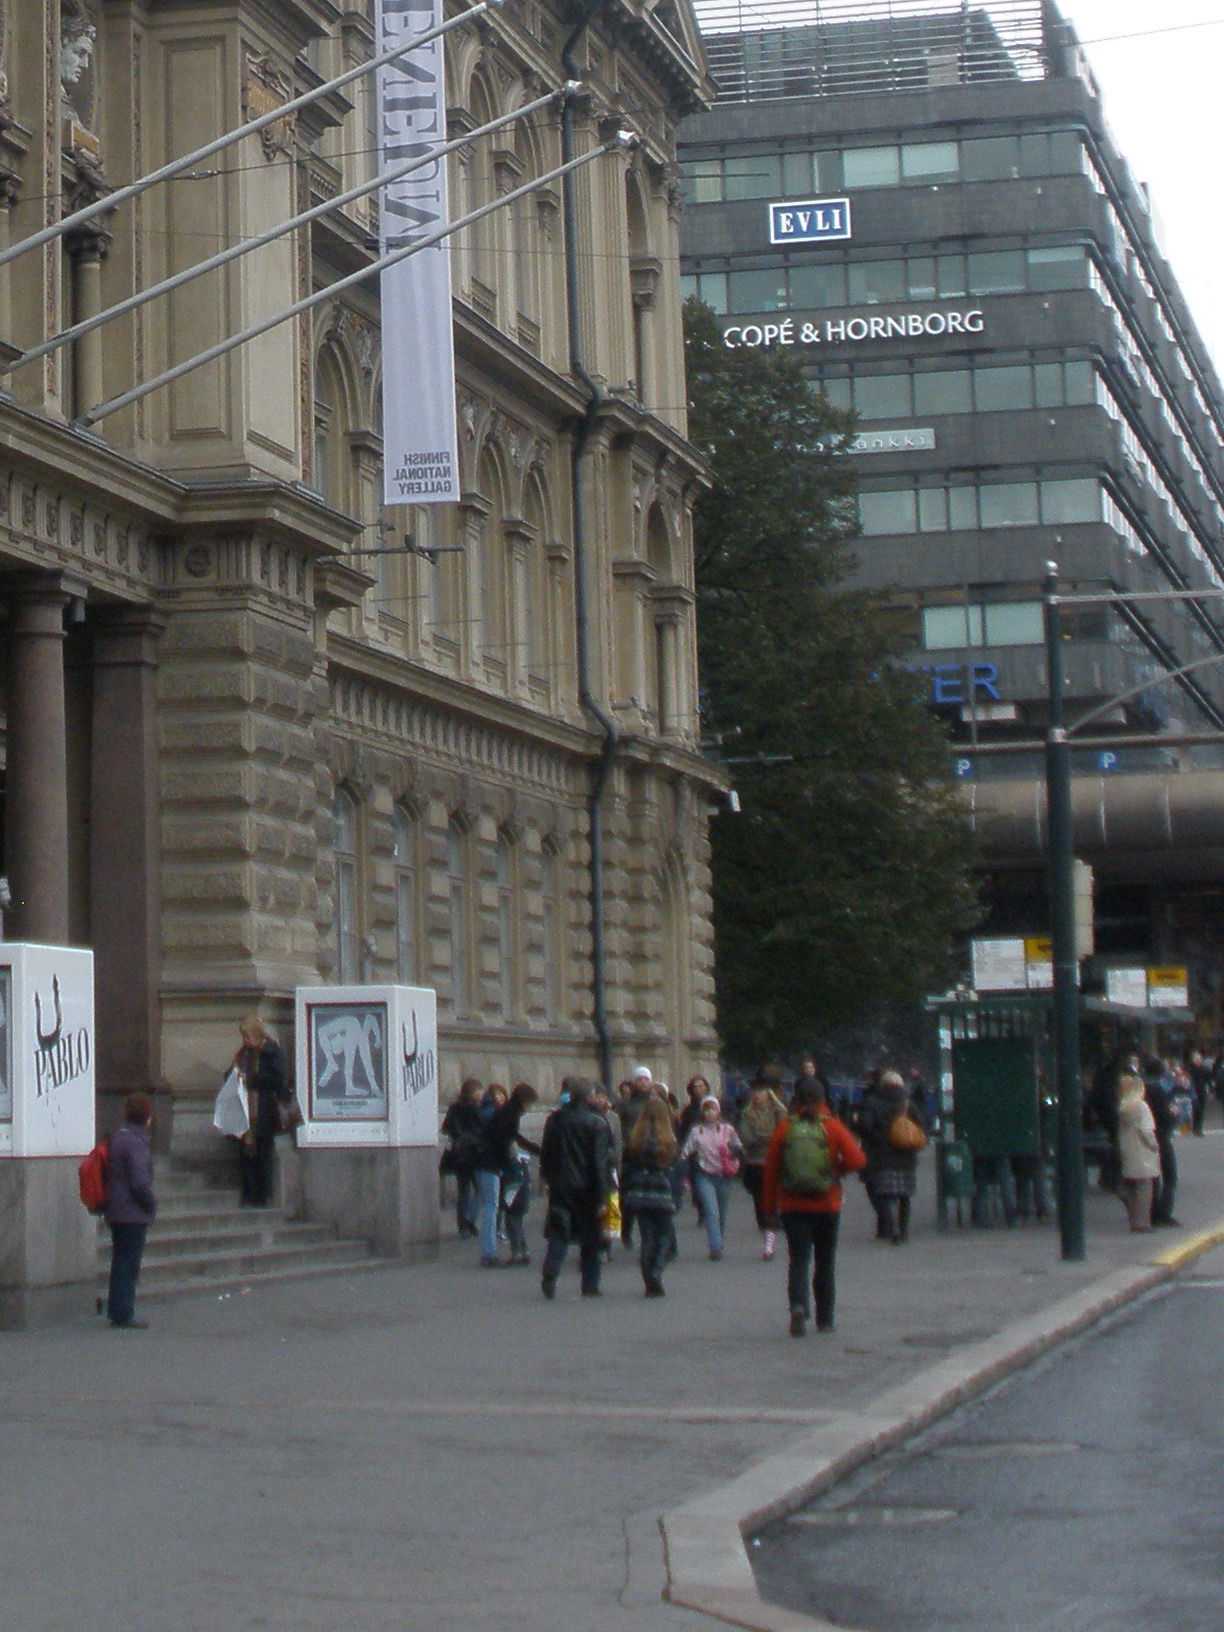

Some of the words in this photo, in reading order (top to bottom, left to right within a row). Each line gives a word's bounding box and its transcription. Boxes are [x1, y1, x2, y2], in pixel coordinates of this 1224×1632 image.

[780, 209, 842, 234] EVLI
[724, 319, 795, 348] COPÉ
[801, 323, 820, 343] &
[826, 311, 984, 342] HORNBORG
[34, 1028, 90, 1098] PABLO
[403, 1049, 434, 1101] PABLO
